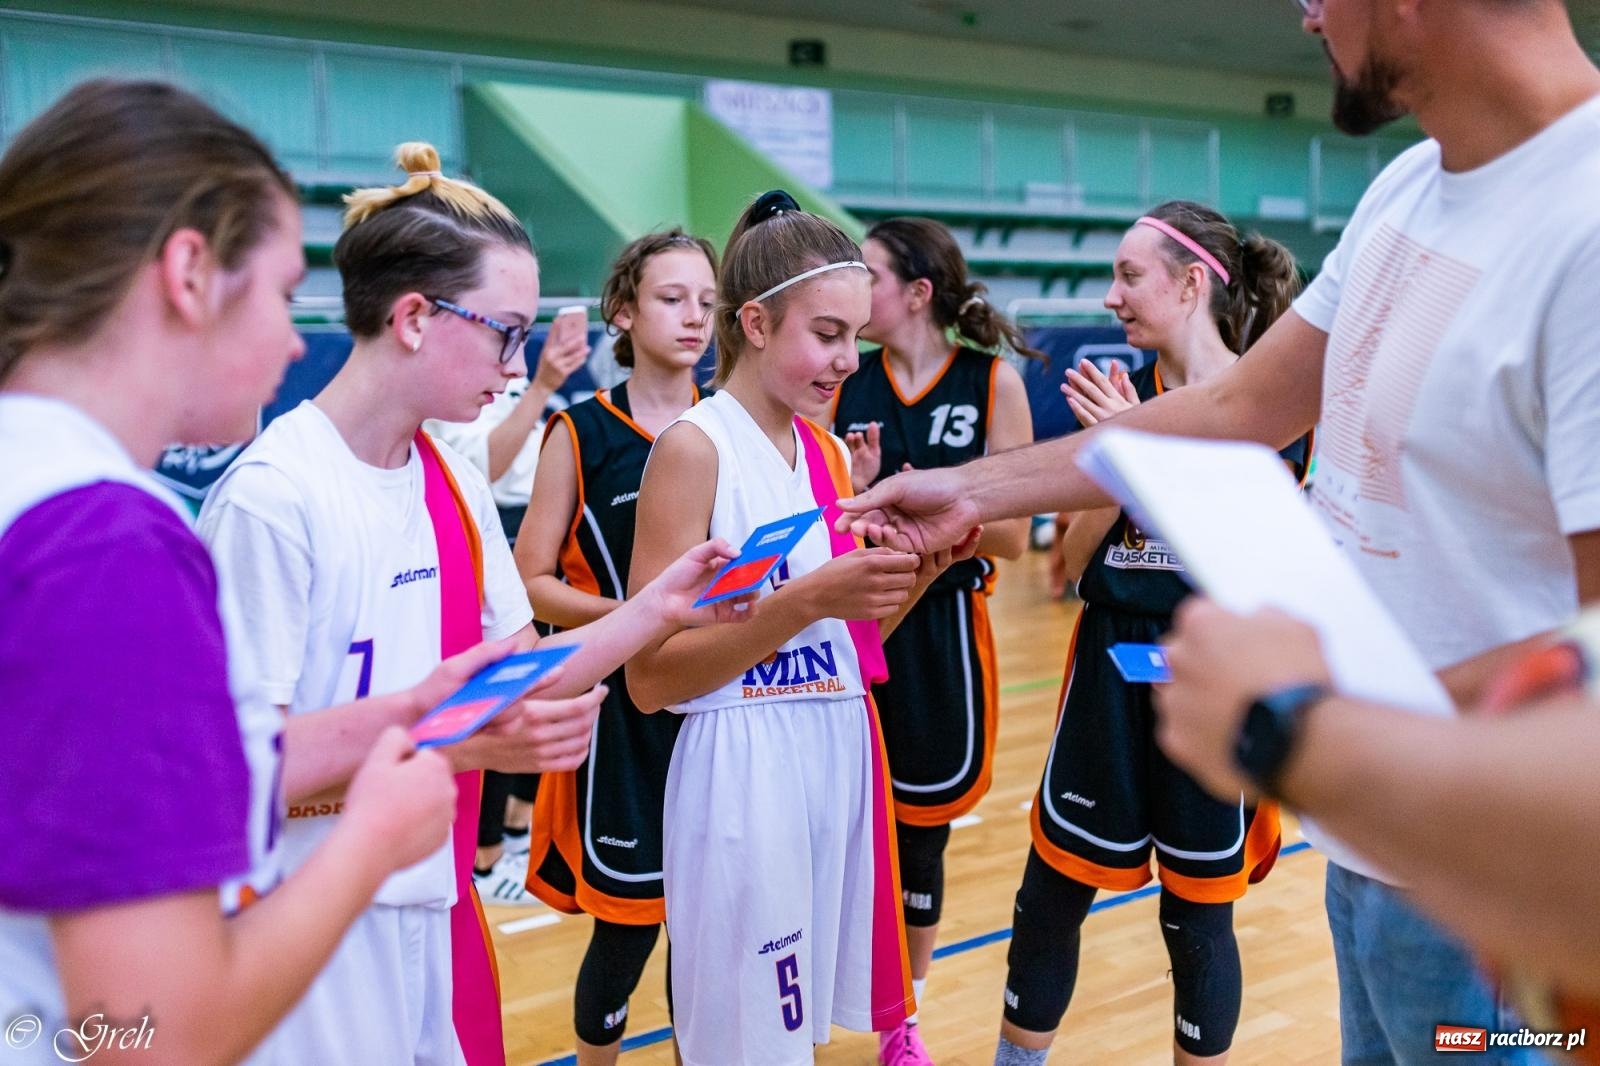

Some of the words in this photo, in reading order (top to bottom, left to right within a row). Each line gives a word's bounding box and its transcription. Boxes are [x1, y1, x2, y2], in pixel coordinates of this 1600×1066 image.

[928, 404, 979, 448] 13
[348, 638, 374, 700] 7
[758, 928, 803, 955] stelman
[776, 953, 804, 1032] 5
